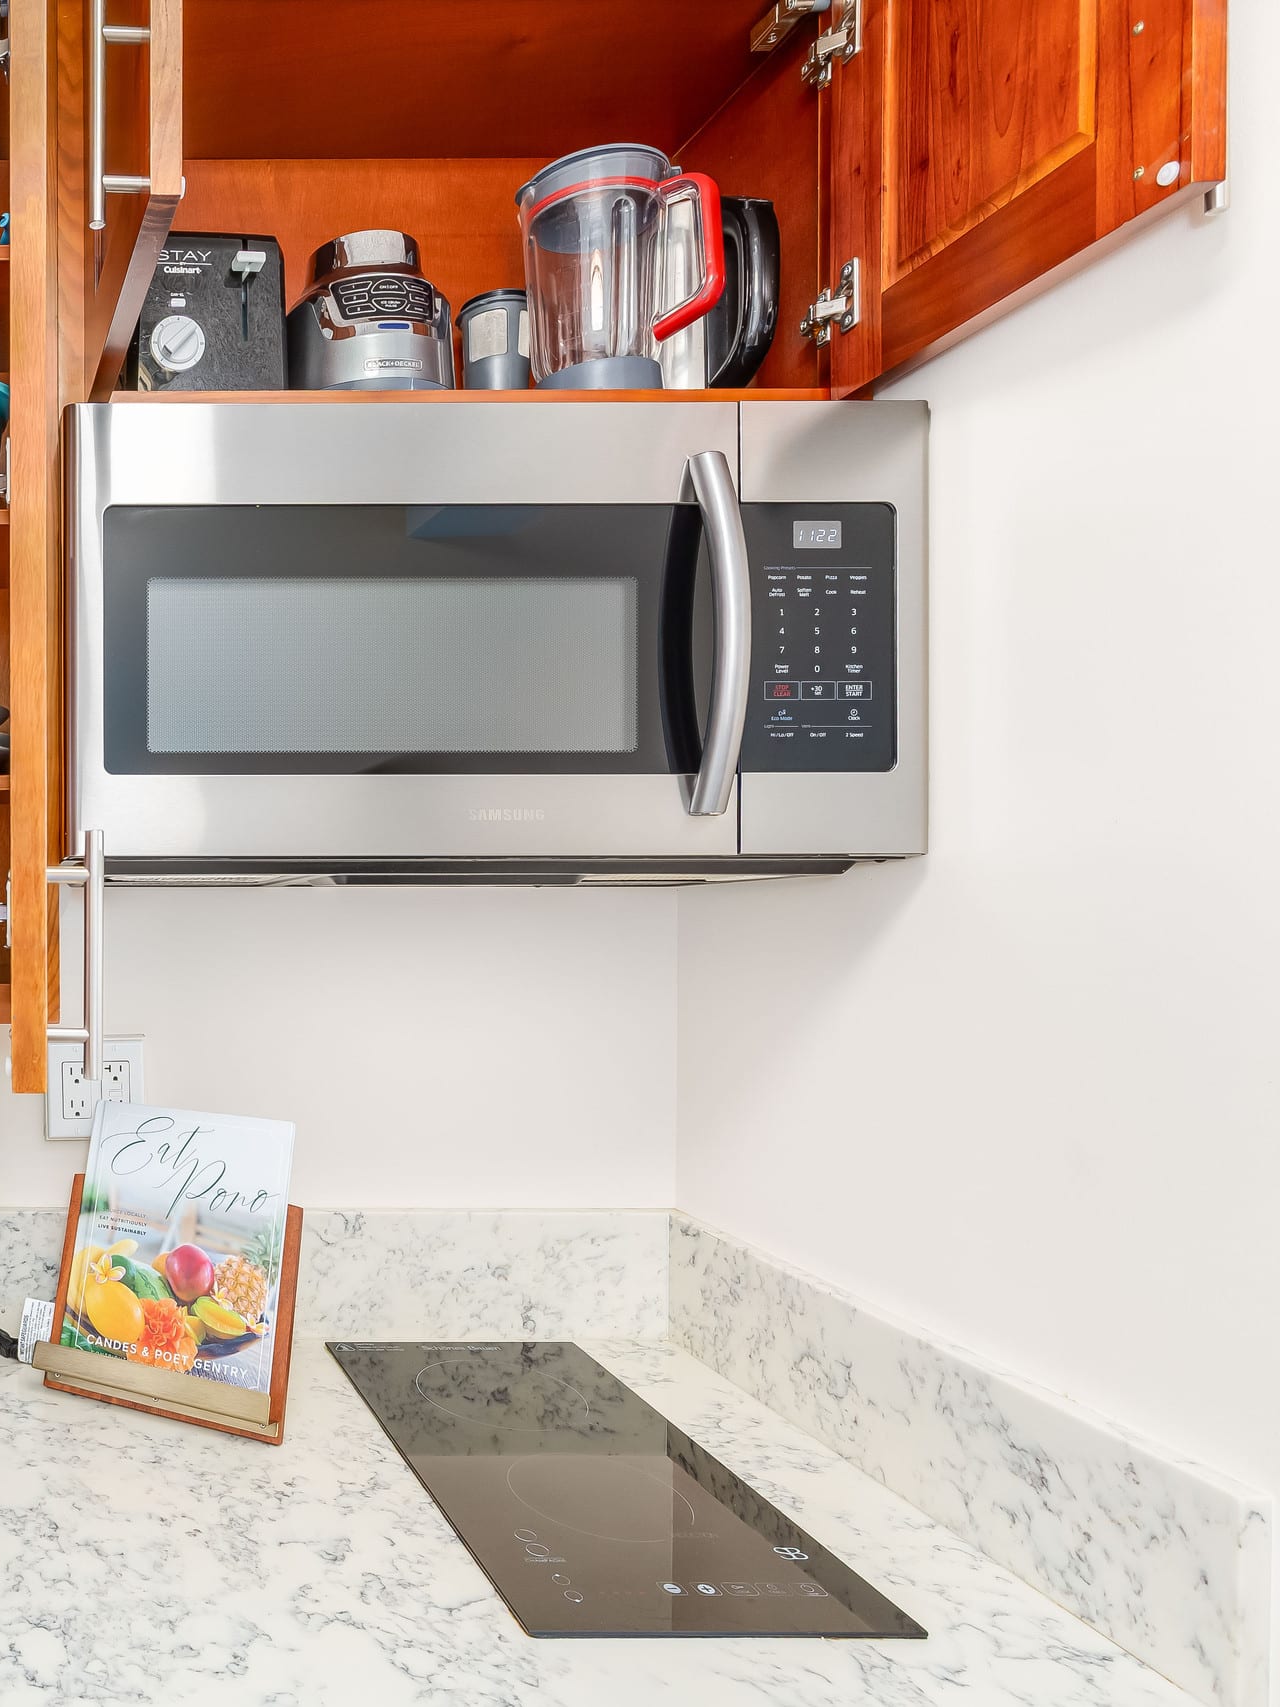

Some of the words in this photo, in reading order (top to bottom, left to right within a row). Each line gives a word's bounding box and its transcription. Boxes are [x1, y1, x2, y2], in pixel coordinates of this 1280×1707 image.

[158, 250, 212, 262] STAY
[164, 266, 201, 274] Cuisinart
[469, 808, 544, 820] SAMSUNG
[101, 1116, 215, 1176] Eat
[153, 1158, 280, 1220] Pono
[110, 1217, 147, 1227] NUTRITIOUSLY
[111, 1225, 147, 1236] SUSTAINABLY
[86, 1334, 138, 1354] CANDES
[141, 1346, 150, 1358] &
[154, 1349, 190, 1366] POET
[193, 1358, 248, 1380] GENTRY
